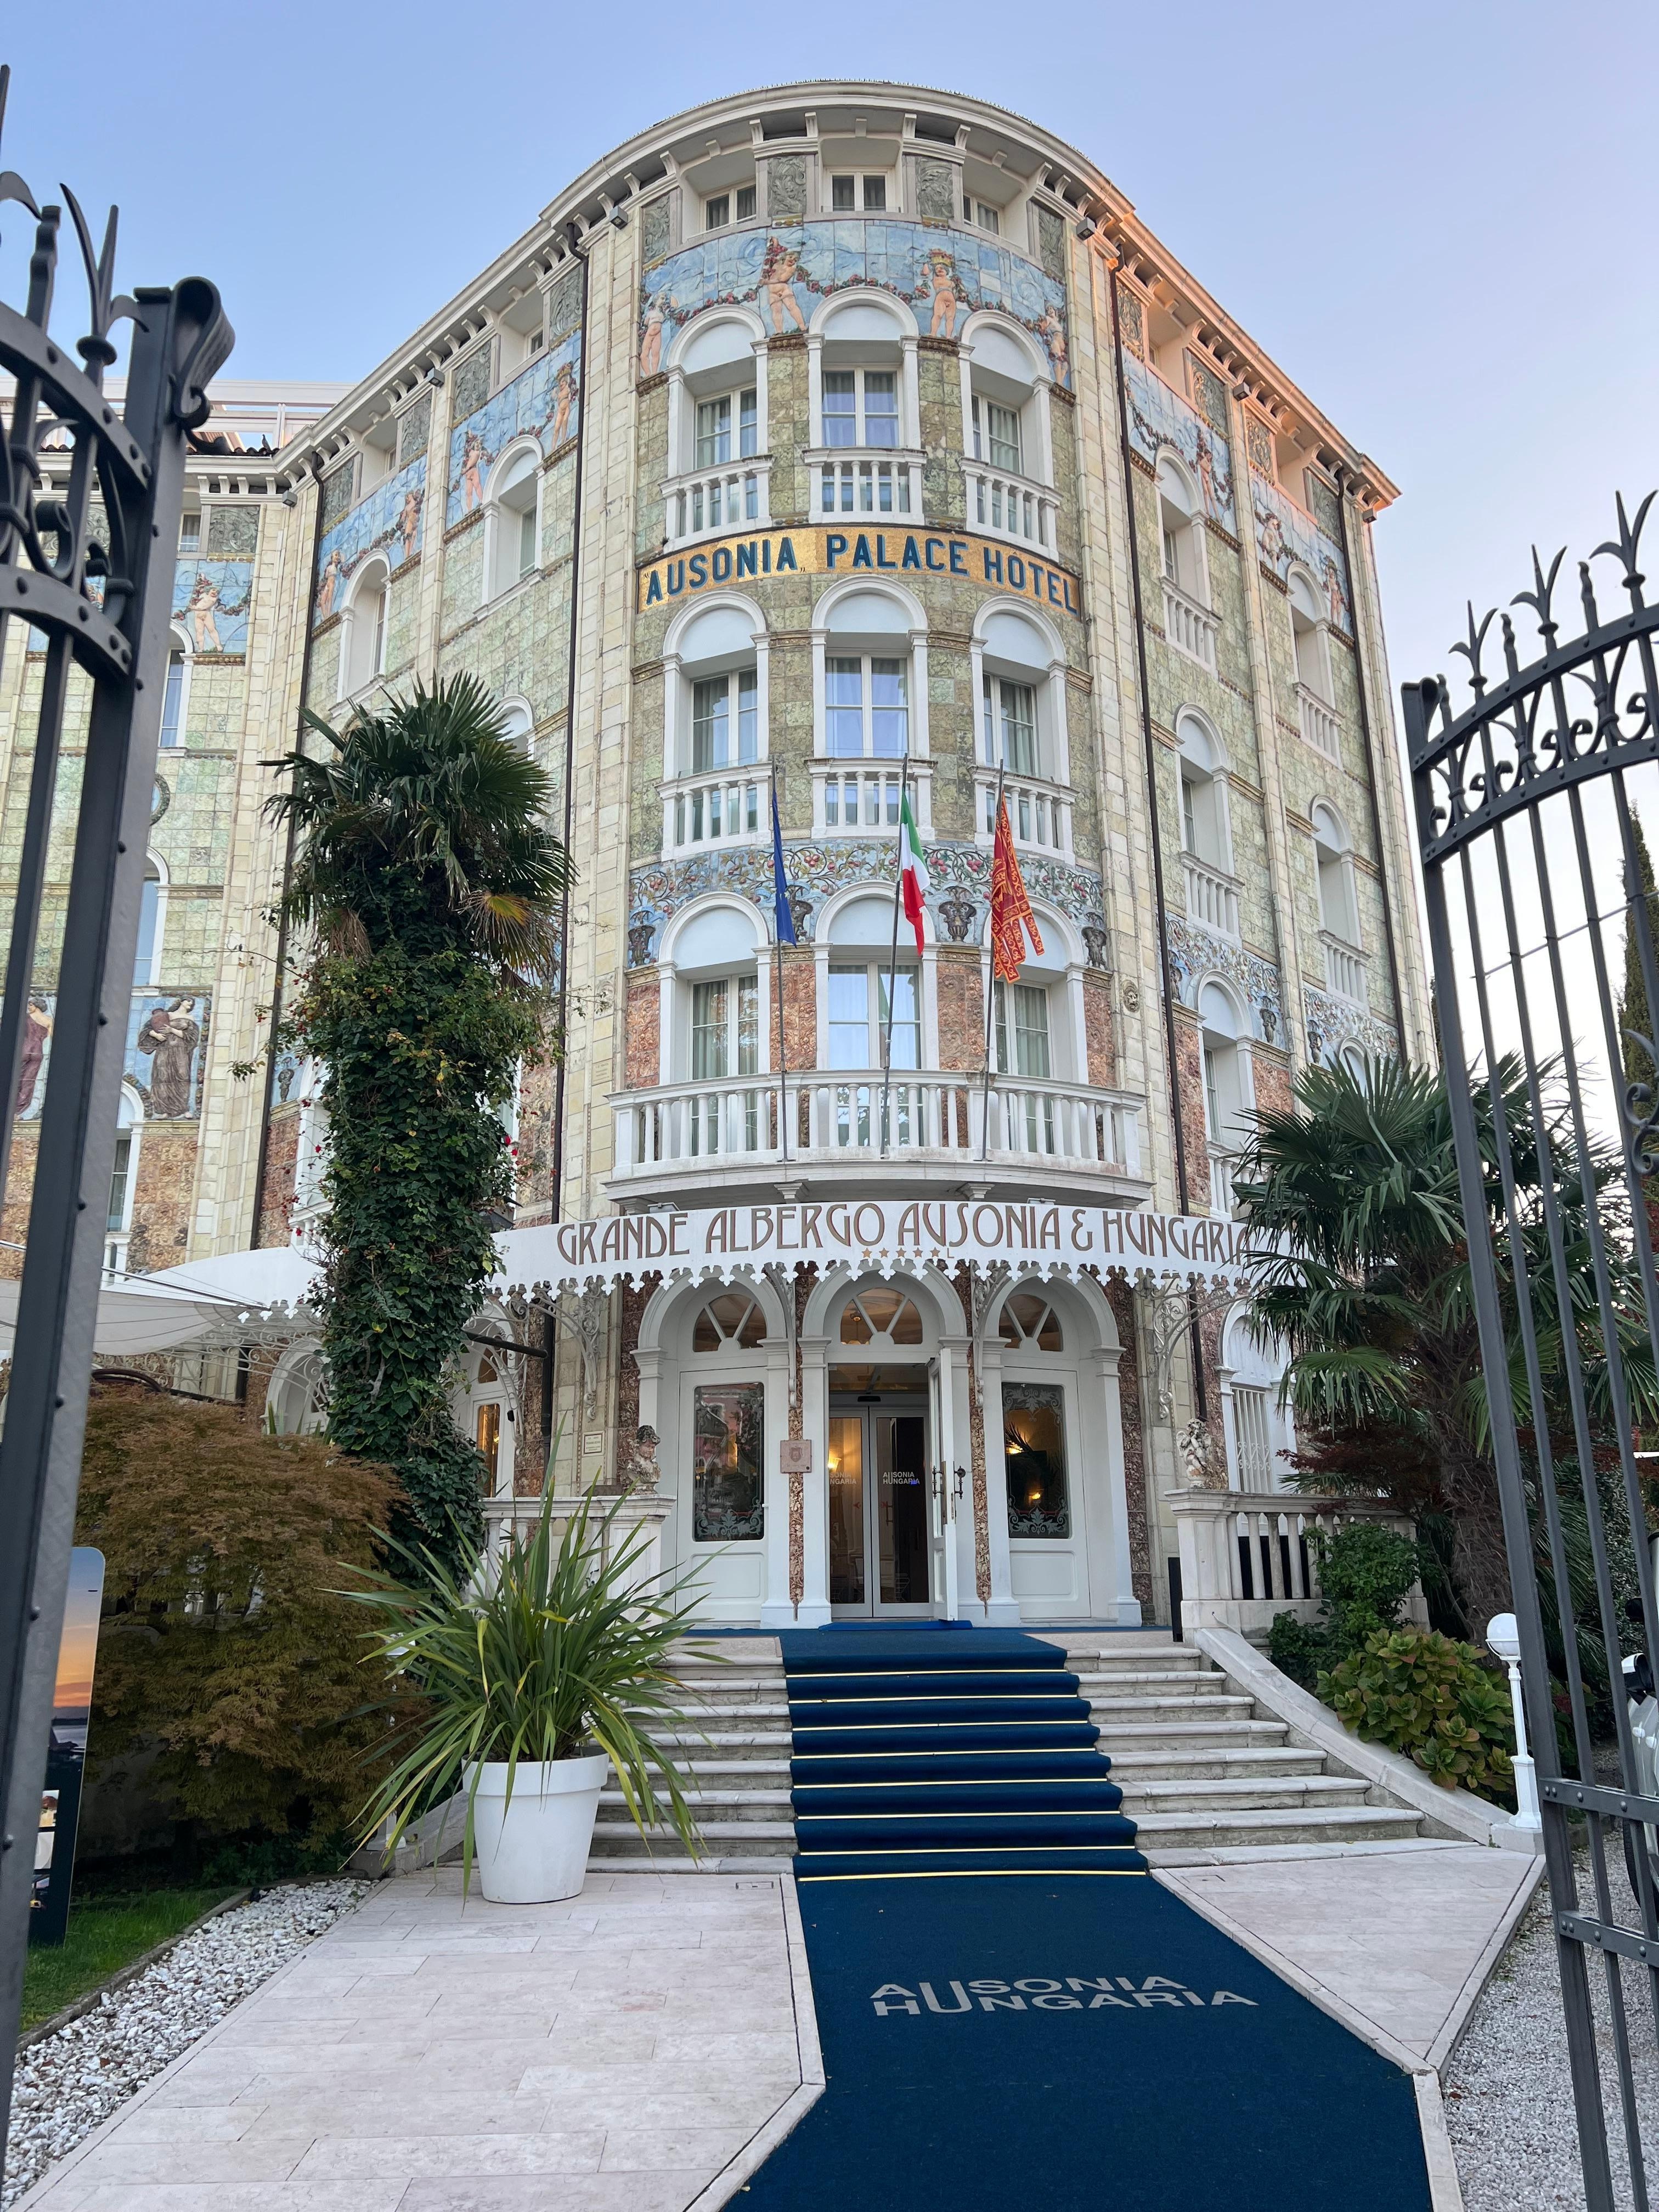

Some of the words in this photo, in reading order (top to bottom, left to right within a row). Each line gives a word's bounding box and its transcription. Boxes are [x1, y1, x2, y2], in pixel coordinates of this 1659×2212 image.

[826, 534, 969, 577] PALACE
[557, 1212, 690, 1266] GRANDE
[705, 1203, 885, 1254] ALBERGO
[897, 1203, 1061, 1250] AUSONIA
[1071, 1209, 1093, 1251] &
[883, 1471, 915, 1482] AUSONIA
[870, 1976, 1188, 2013] AUSONIA
[873, 1981, 1259, 2016] HUNGARIA
